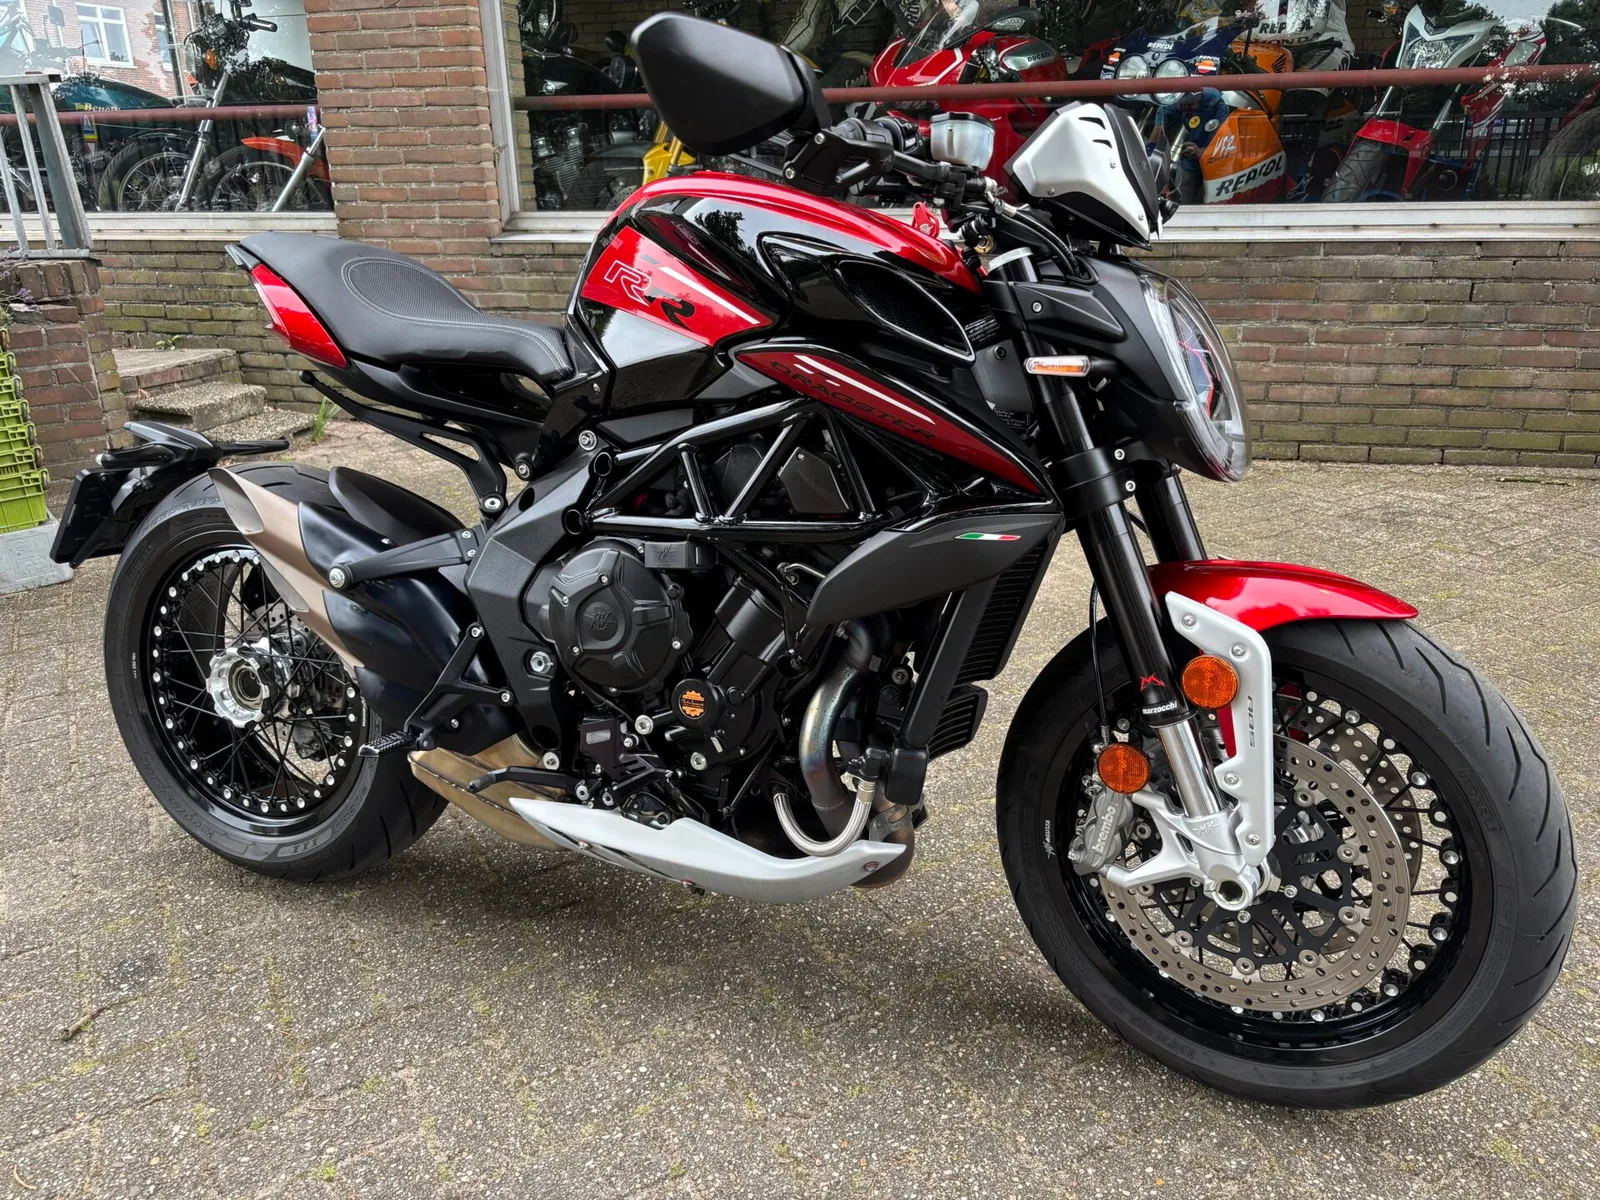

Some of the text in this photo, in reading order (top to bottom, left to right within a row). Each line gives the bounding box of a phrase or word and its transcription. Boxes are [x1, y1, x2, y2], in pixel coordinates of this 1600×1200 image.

[1258, 18, 1314, 34] REPOL
[1147, 42, 1175, 51] REPSOL
[1027, 52, 1051, 63] DUCATI
[1215, 155, 1283, 197] REPSOL
[769, 360, 938, 441] DRAGSTER
[1142, 701, 1178, 715] marzocchi
[1092, 806, 1117, 858] brembo
